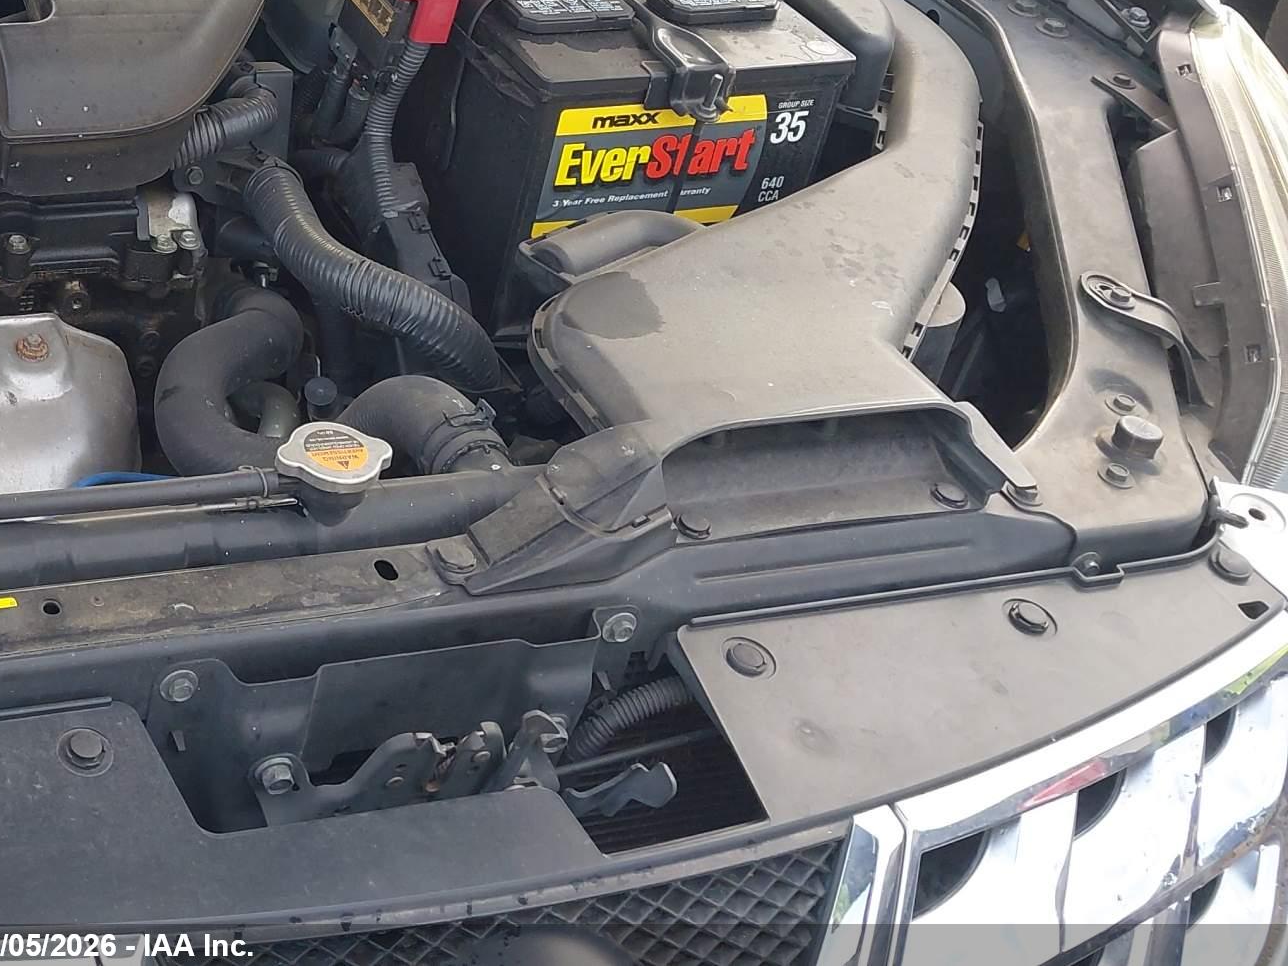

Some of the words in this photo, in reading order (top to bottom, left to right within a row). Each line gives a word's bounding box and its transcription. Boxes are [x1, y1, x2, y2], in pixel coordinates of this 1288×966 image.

[778, 101, 800, 109] GROUP
[800, 99, 814, 107] SIZE
[592, 111, 660, 130] maxx
[770, 110, 809, 144] 35
[761, 176, 785, 189] 640
[562, 199, 582, 207] Year
[584, 197, 606, 205] Free
[607, 190, 669, 202] Replacement
[758, 190, 780, 202] CCA
